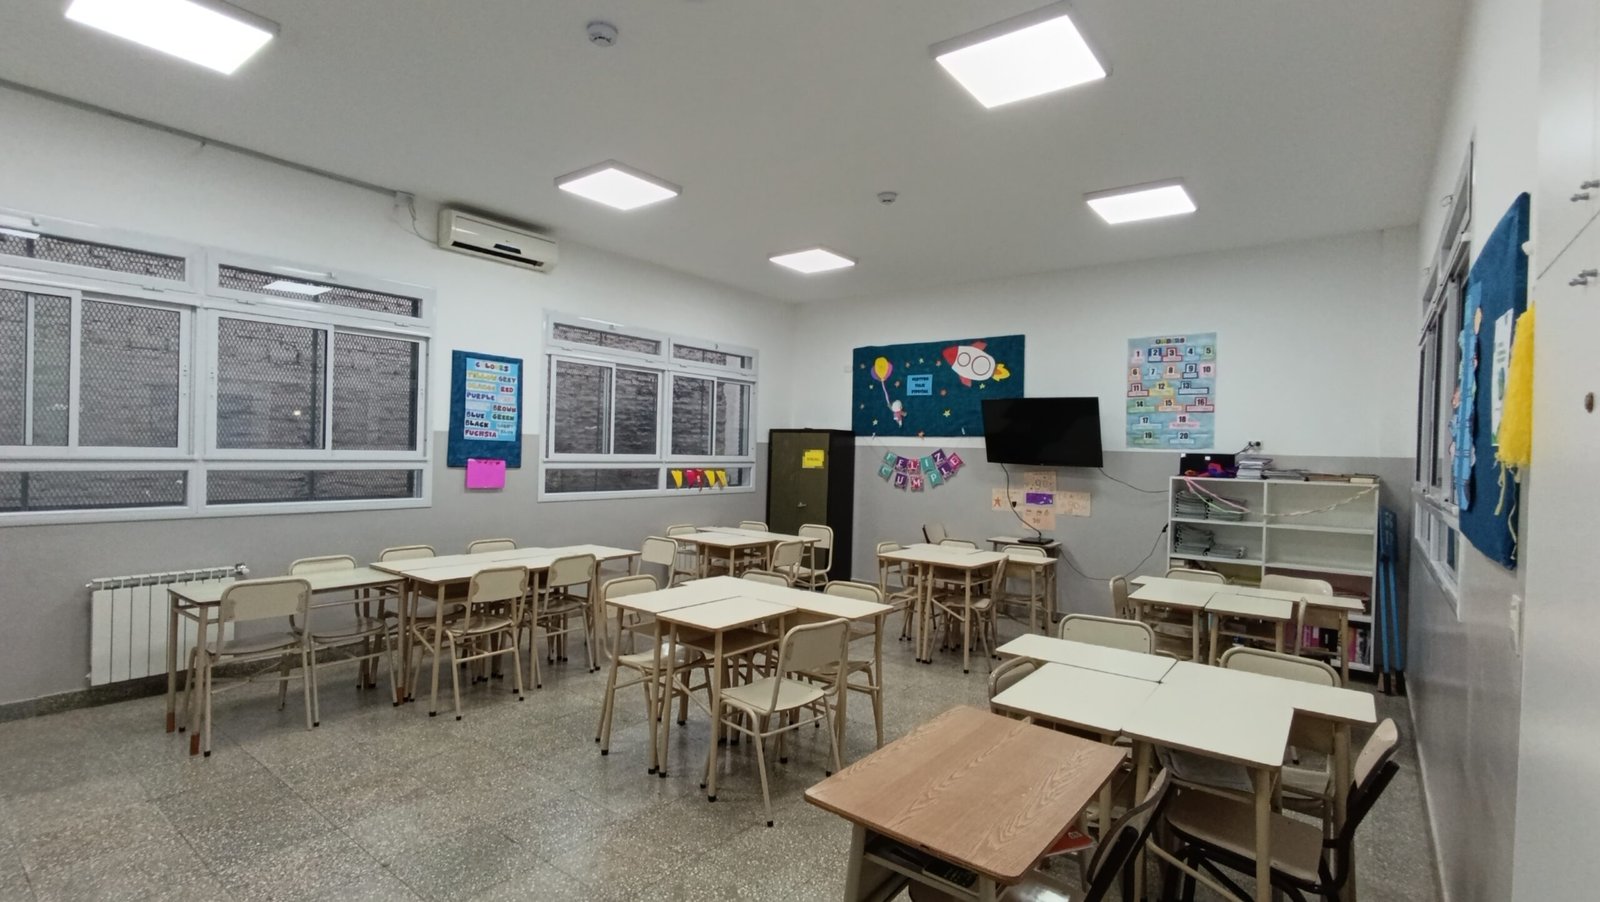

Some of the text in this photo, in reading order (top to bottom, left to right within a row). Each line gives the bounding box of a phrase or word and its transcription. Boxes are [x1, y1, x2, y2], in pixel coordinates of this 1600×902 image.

[466, 392, 495, 401] PURPLE
[493, 404, 516, 413] BROWN
[467, 411, 485, 419] BLUE
[492, 413, 515, 421] GREEN
[465, 419, 489, 428] BLACK
[465, 429, 497, 438] FUCHSIA
[886, 452, 943, 469] FELIZ
